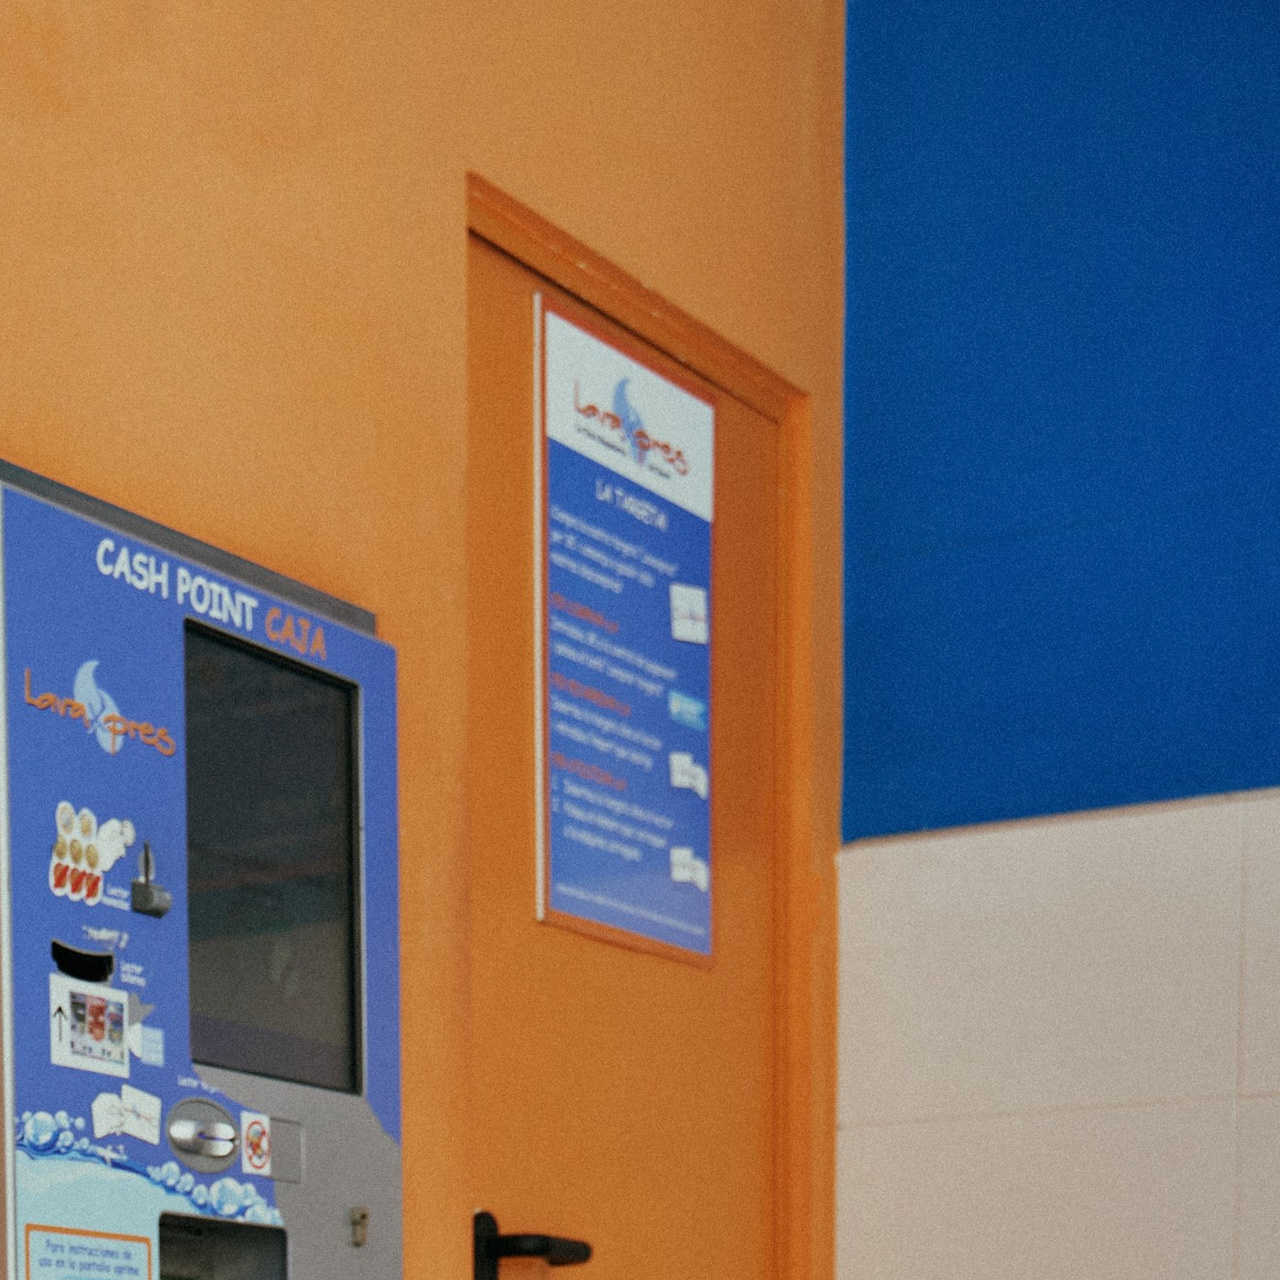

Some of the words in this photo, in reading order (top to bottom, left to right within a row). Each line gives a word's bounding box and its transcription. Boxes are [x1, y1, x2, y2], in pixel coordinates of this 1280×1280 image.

[96, 538, 170, 600] CASH
[176, 566, 260, 632] POINT
[265, 606, 328, 661] CAJA
